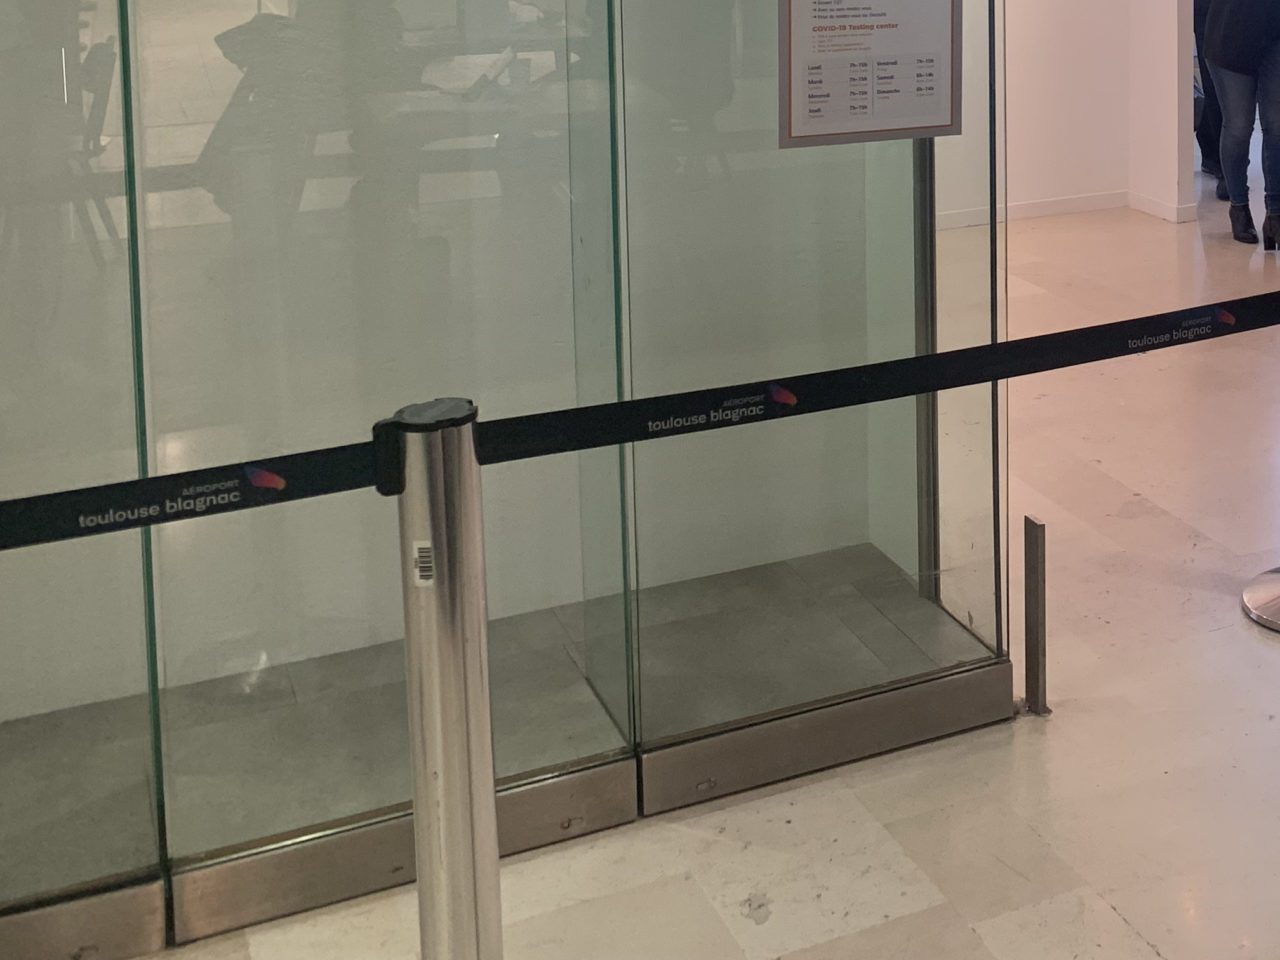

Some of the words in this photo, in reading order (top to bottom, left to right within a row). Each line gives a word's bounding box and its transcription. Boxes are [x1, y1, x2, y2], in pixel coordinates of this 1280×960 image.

[1128, 332, 1170, 348] toulouse
[1173, 325, 1212, 340] blagnac
[648, 413, 707, 432] toulouse
[710, 405, 764, 422] blagnac
[78, 503, 161, 528] toulouse
[165, 490, 241, 514] blagnac
